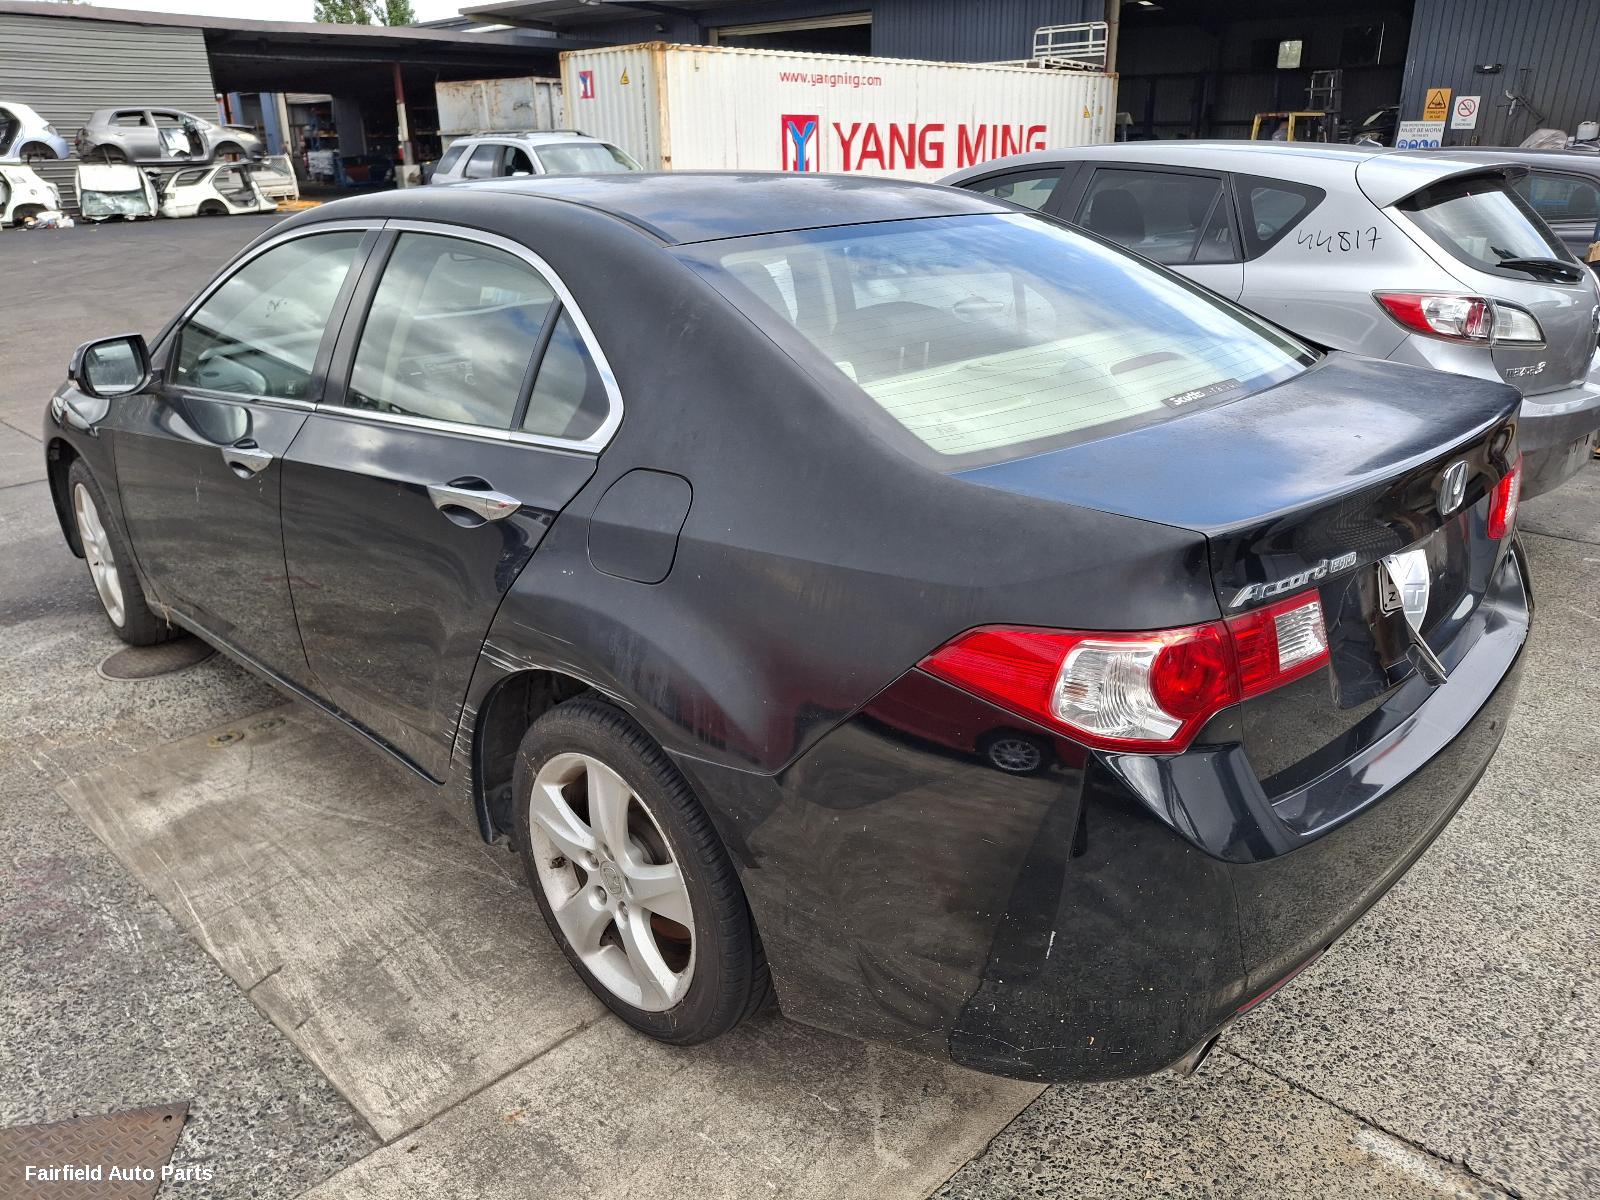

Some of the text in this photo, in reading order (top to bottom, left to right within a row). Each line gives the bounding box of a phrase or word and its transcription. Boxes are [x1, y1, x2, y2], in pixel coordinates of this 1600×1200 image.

[779, 72, 882, 89] www.yangming.com
[832, 123, 1047, 172] YANG MING
[1297, 226, 1382, 253] 44817
[1228, 559, 1328, 608] Accord
